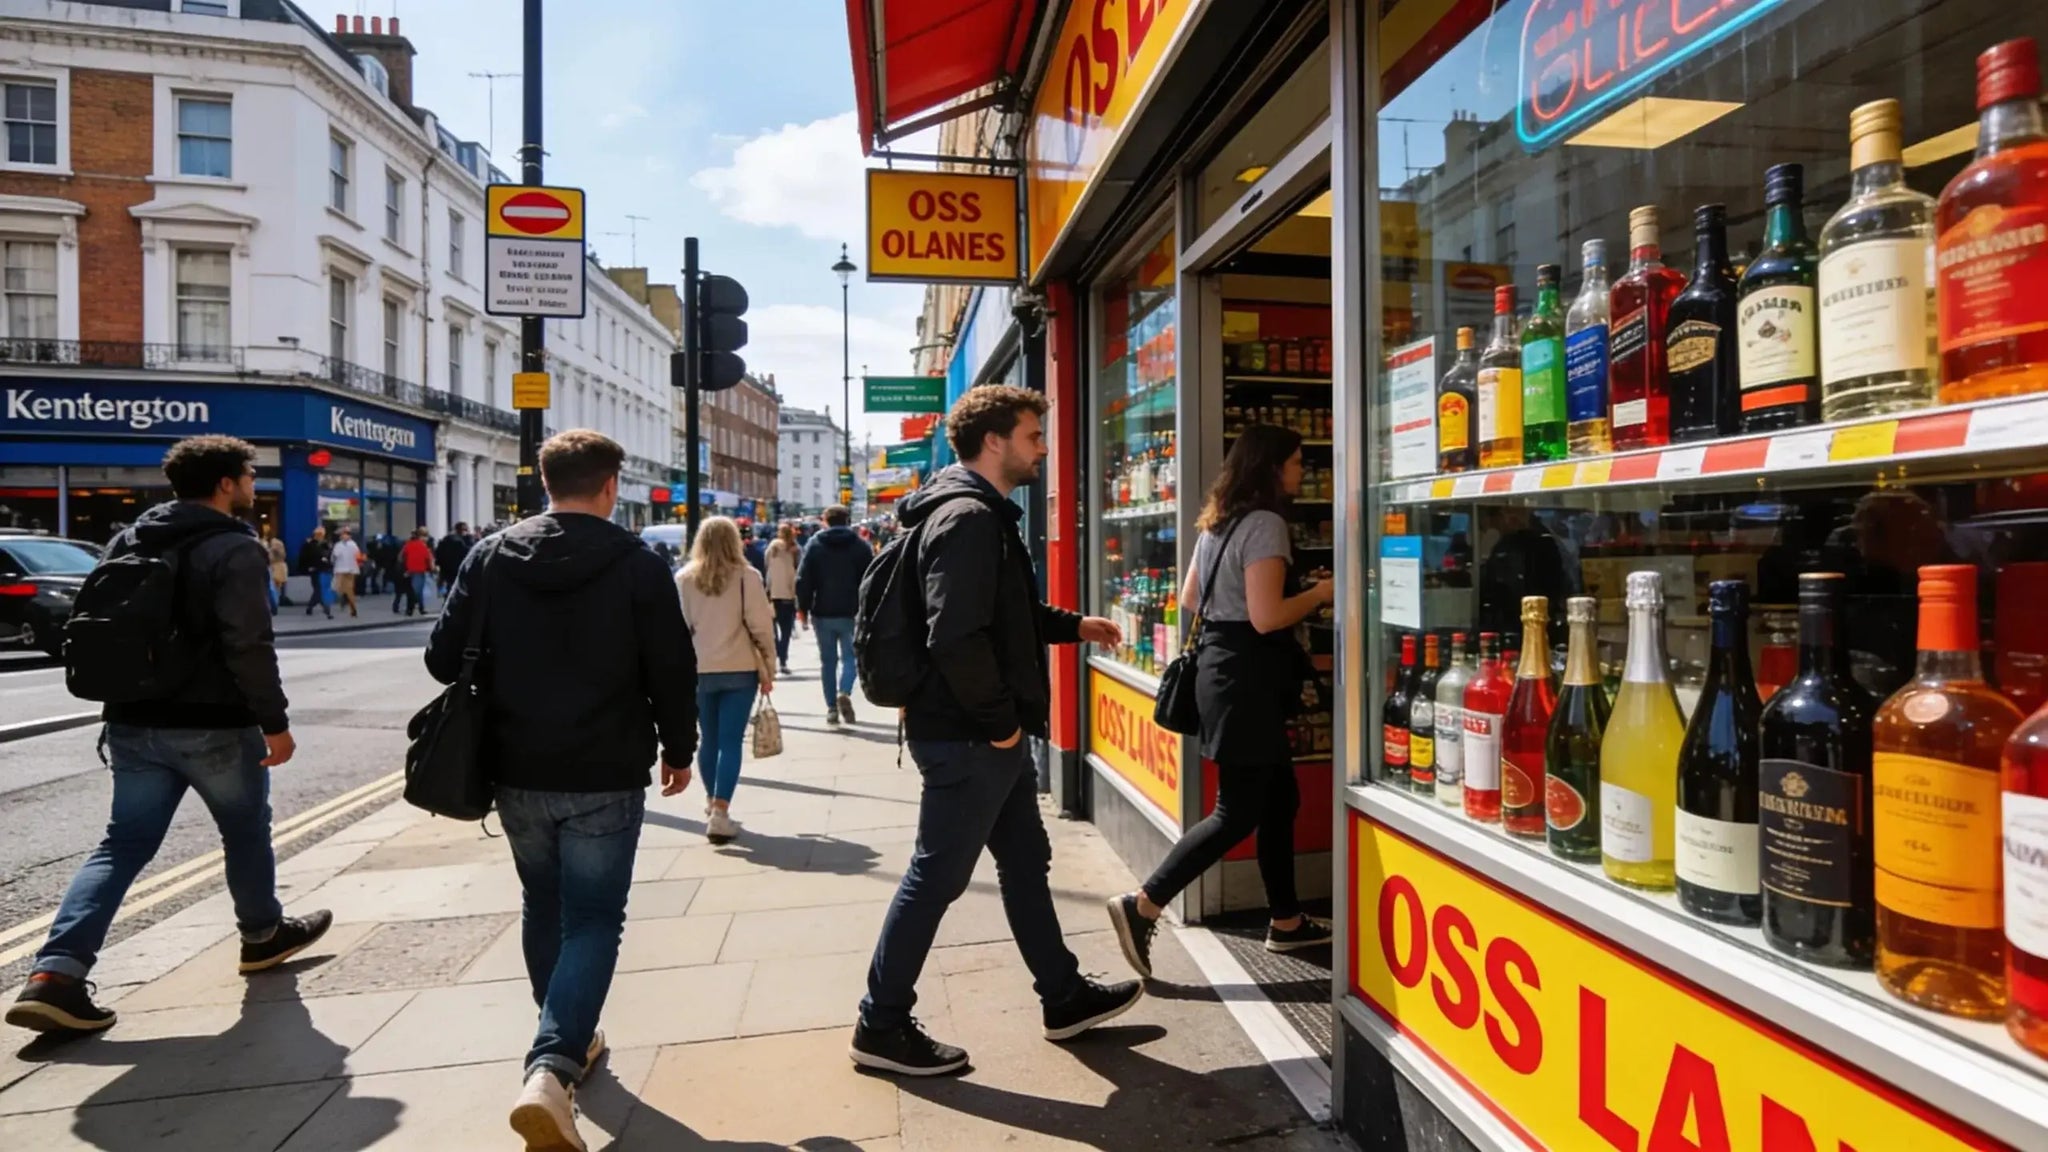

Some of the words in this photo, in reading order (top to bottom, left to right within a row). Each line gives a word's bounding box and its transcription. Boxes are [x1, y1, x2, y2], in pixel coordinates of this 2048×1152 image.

[908, 189, 982, 223] OSS
[881, 229, 1006, 263] OLANES
[1098, 693, 1125, 752] OSS
[1378, 874, 1543, 1075] OSS
